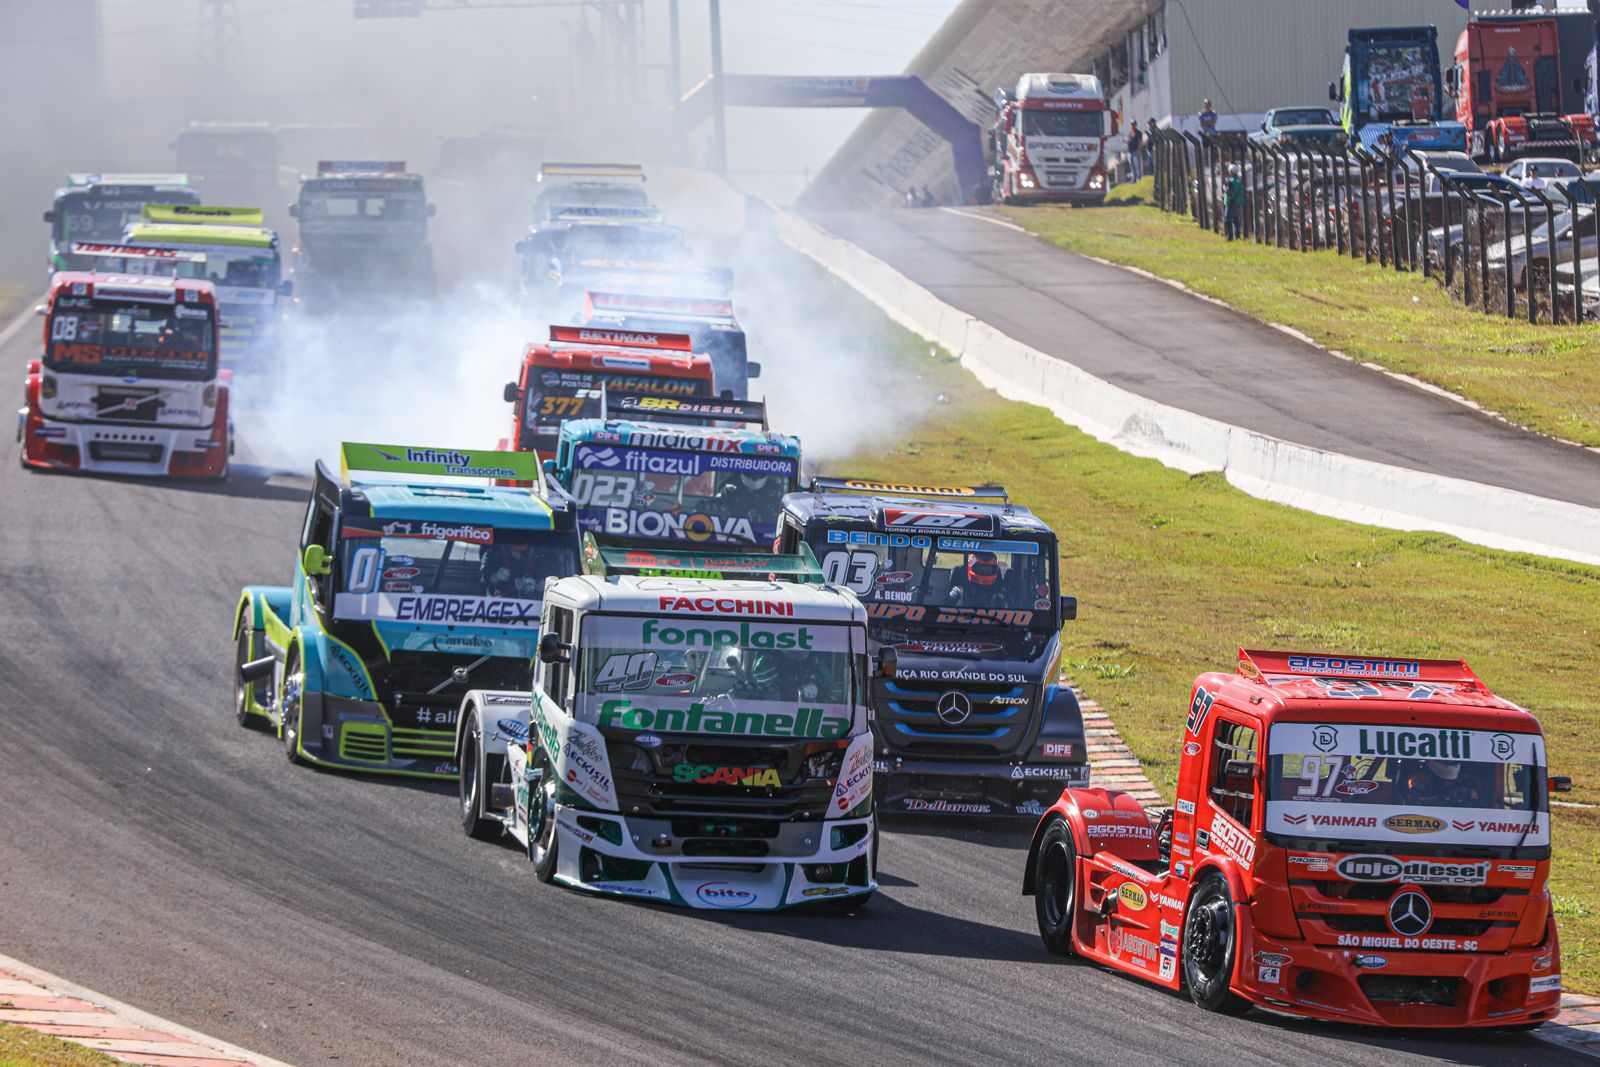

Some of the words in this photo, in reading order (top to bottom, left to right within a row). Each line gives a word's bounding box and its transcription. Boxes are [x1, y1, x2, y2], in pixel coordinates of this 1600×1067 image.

[53, 316, 79, 340] 08
[561, 372, 580, 382] REDE
[582, 374, 593, 382] DE
[593, 375, 697, 399] ZAFALON
[538, 396, 586, 416] 377
[406, 449, 471, 468] Infinity
[624, 451, 700, 475] fitazul
[709, 457, 793, 473] DISTRIBUIDORA
[444, 465, 517, 477] Transportes
[572, 474, 636, 508] 023
[605, 508, 757, 544] BIONOVA
[827, 529, 932, 547] BENDO
[821, 550, 879, 598] 03
[658, 595, 794, 617] FACCHINI
[875, 590, 884, 600] A.
[884, 590, 912, 602] BENDO
[395, 597, 536, 626] EMBREAGEX
[936, 606, 1034, 626] BENDO
[641, 619, 813, 652] fonplast
[593, 650, 660, 693] 40
[920, 670, 939, 679] RIO
[941, 670, 987, 681] GRANDE
[989, 672, 1005, 681] DO
[1008, 673, 1028, 683] SUL
[597, 698, 850, 738] Fontanella
[1185, 684, 1216, 738] 97
[1046, 744, 1072, 756] DIFE
[1359, 727, 1471, 760] Lucatti
[672, 763, 781, 788] SCANIA
[1024, 767, 1072, 778] ECKISIL
[1297, 756, 1346, 797] 97
[1311, 813, 1377, 828] YANMAR
[1388, 818, 1442, 830] SERMAQ
[1478, 820, 1540, 836] YANMAR
[1403, 875, 1447, 883] POWER
[1337, 934, 1361, 949] SÃO
[1361, 936, 1403, 949] MIGUEL
[1404, 938, 1420, 949] DO
[1421, 939, 1456, 950] OESTE
[1462, 940, 1478, 951] SC
